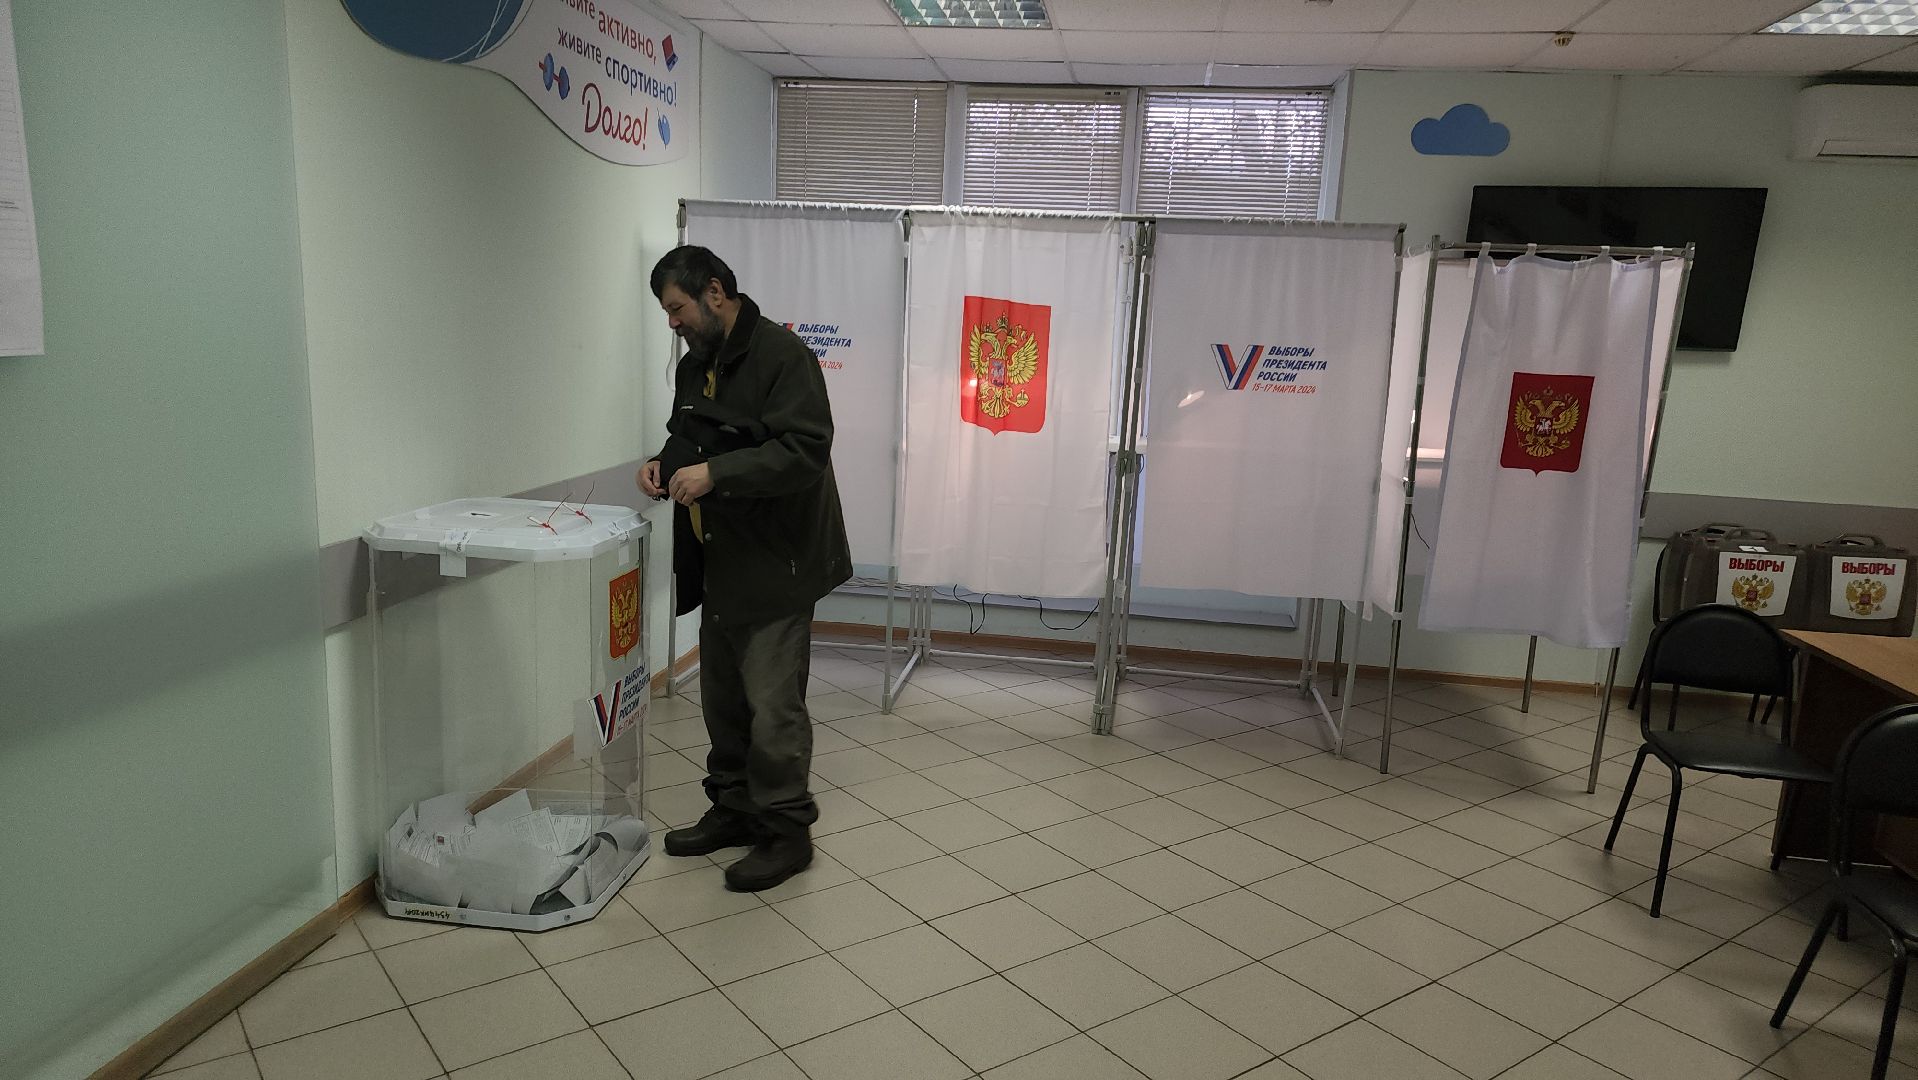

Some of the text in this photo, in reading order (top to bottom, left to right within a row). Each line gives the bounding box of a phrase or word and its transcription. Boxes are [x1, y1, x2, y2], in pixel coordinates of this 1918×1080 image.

[561, 0, 657, 64] вите активно,
[557, 27, 677, 107] живите спортивно!
[582, 83, 649, 150] Долго!
[798, 323, 840, 335] ВЫБОРЫ
[801, 336, 852, 348] РЕЗИДЕНТА
[1268, 345, 1315, 357] ВЫБОРЫ
[1262, 358, 1328, 371] ПРЕЗИДЕНТА
[1256, 371, 1298, 382] РОССИИ
[1252, 383, 1317, 394] 15-17 МАРТА 2024
[1728, 557, 1786, 573] ВЫБОРЫ
[1841, 561, 1896, 576] ВЫБОРЫ
